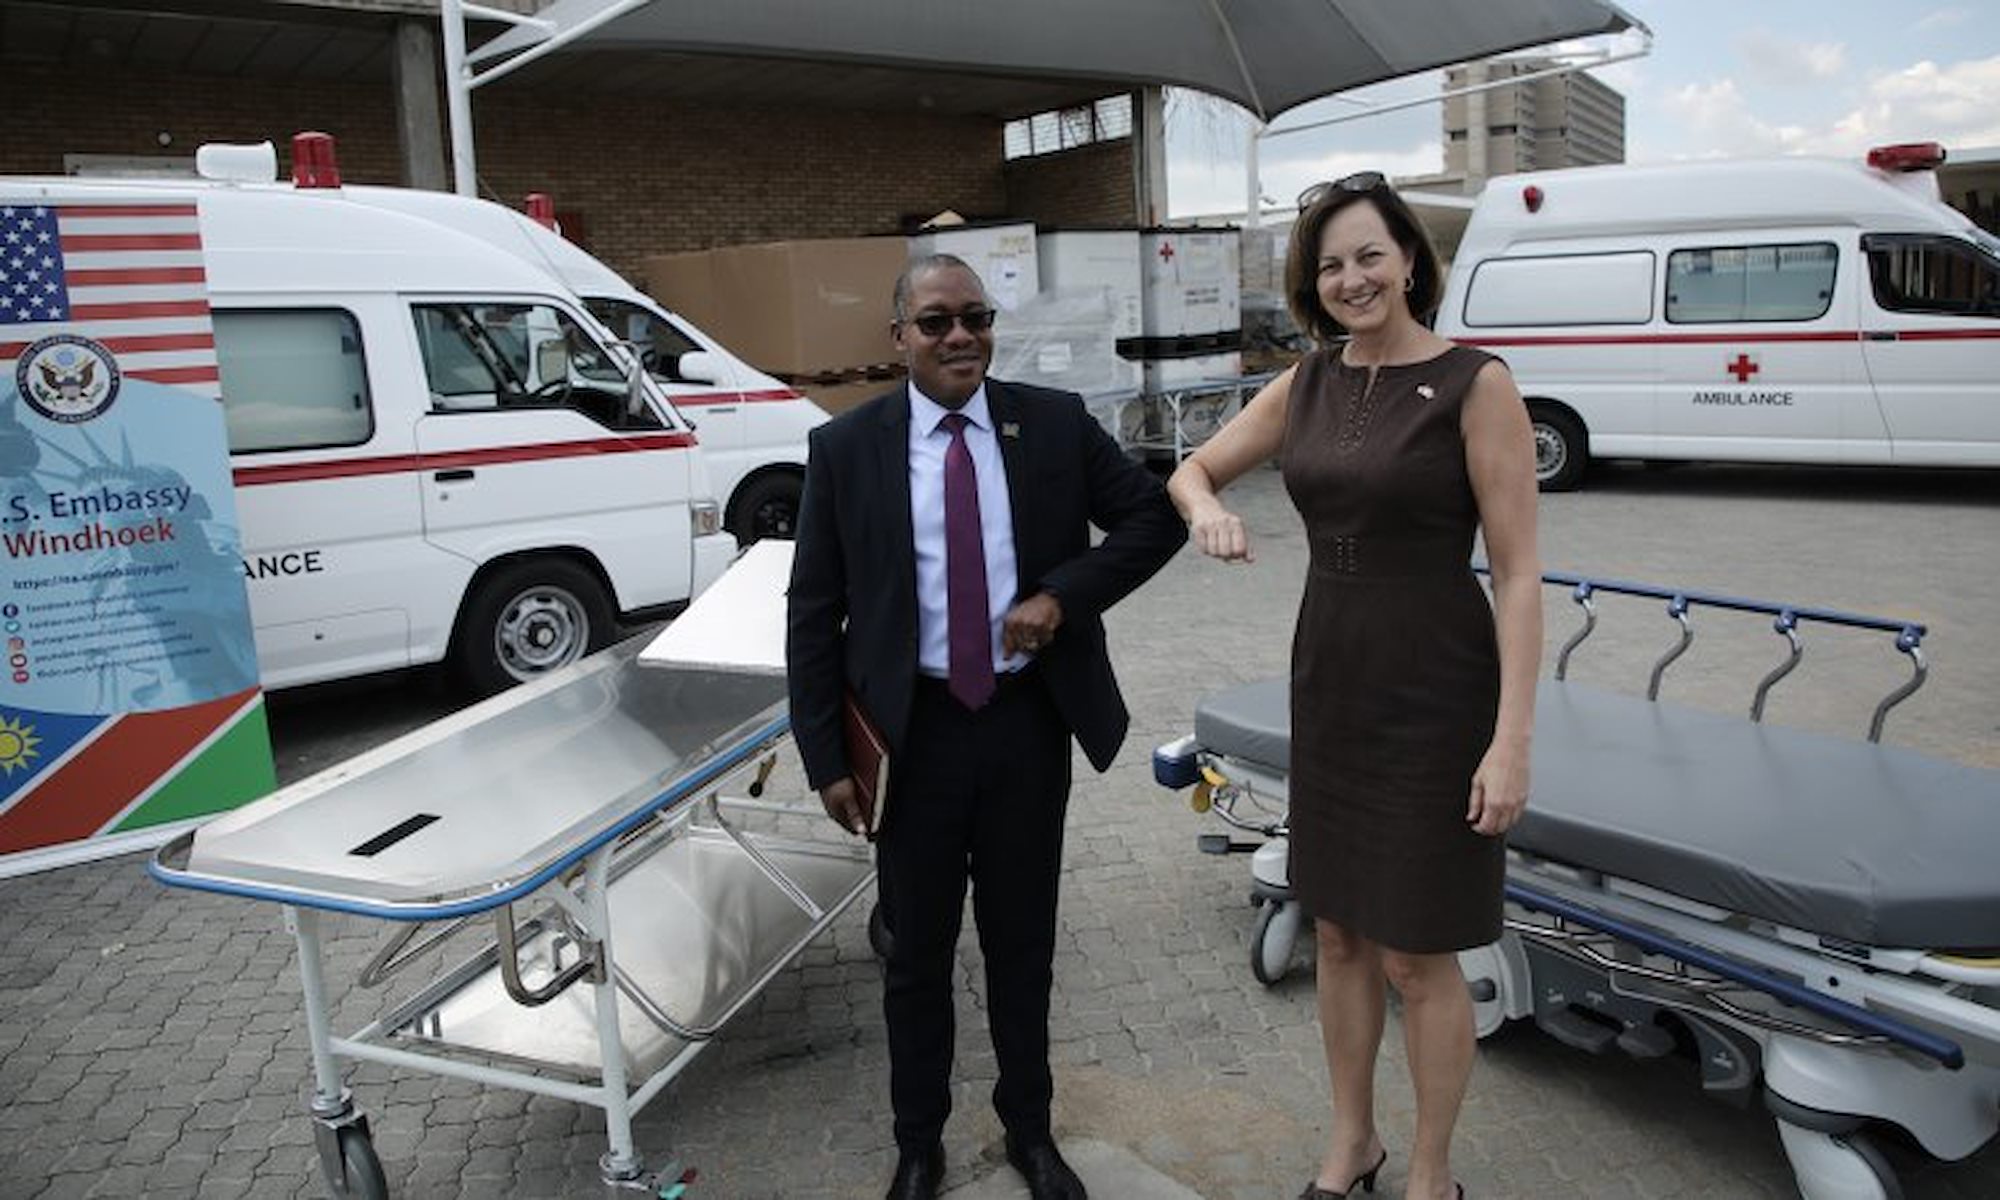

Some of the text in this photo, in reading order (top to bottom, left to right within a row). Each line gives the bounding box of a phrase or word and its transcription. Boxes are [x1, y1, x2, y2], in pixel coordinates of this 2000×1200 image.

[1691, 391, 1794, 406] AMBULANCE
[48, 485, 192, 518] Embassy
[2, 517, 175, 558] Windhoek
